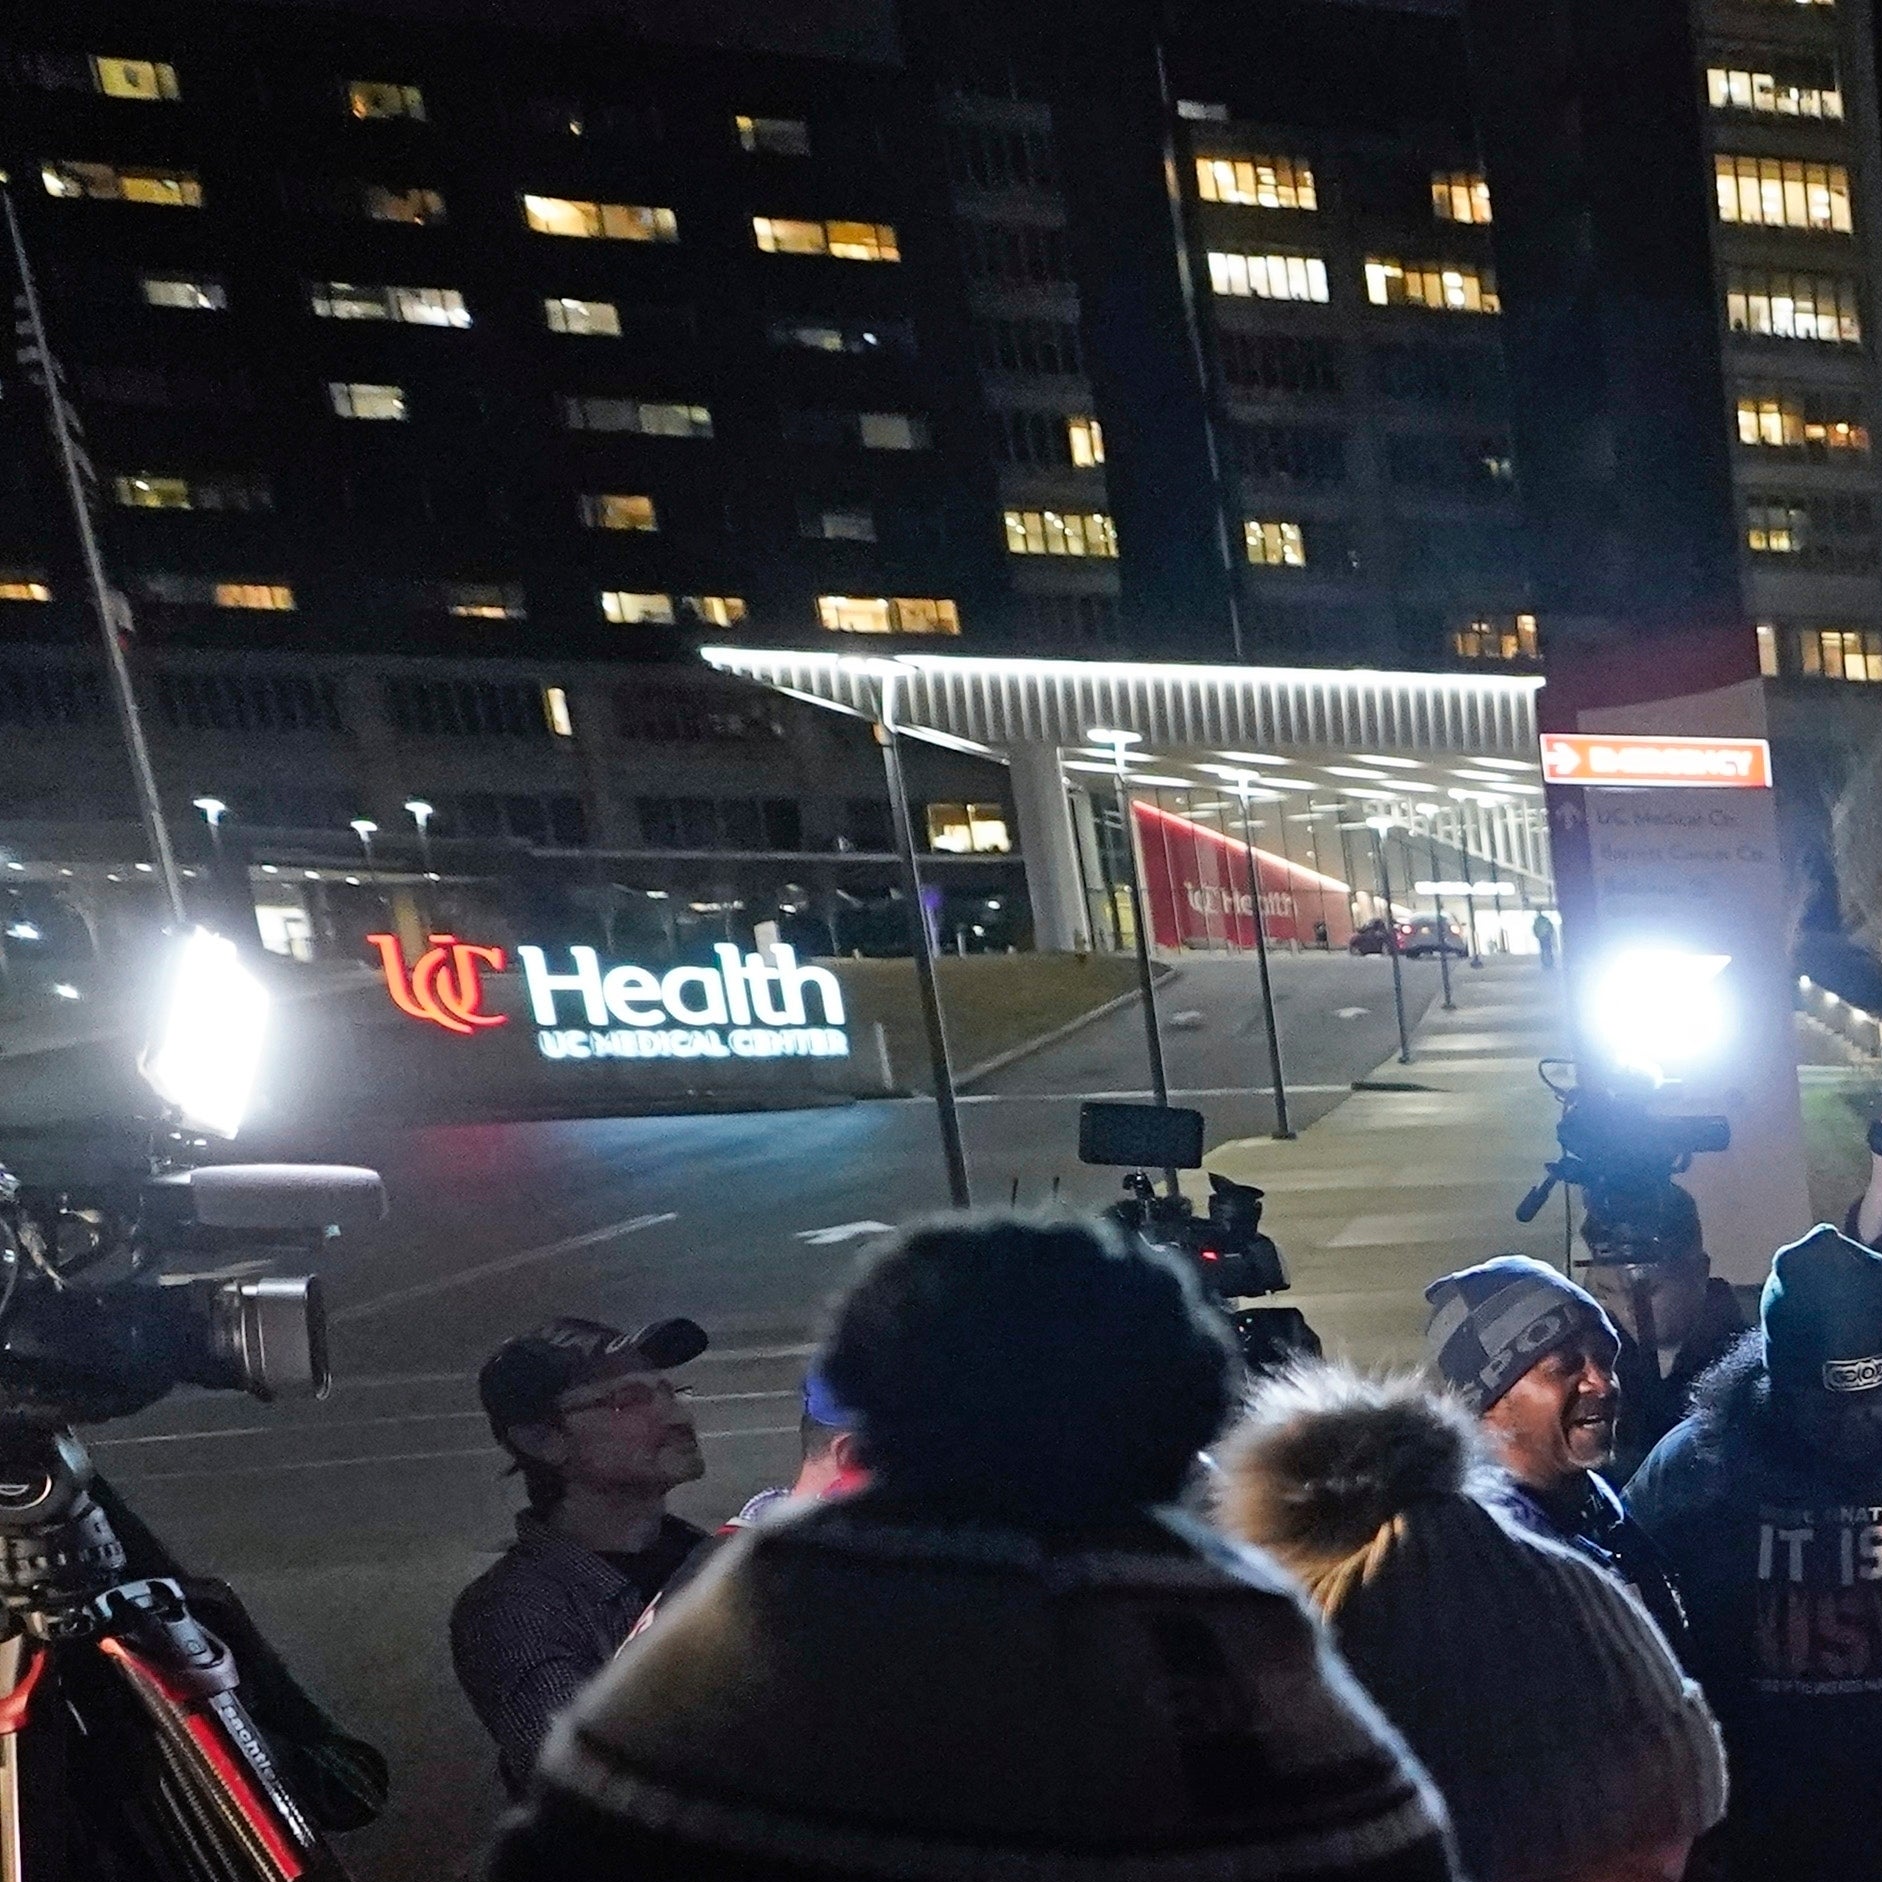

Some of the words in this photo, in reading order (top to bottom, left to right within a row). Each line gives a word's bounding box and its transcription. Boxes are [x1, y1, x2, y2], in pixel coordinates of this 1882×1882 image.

[518, 943, 847, 1027] Health
[538, 1030, 591, 1058] UC
[599, 1030, 730, 1058] MEDICAL
[729, 1029, 850, 1058] CENTER
[1757, 1523, 1815, 1582] IT
